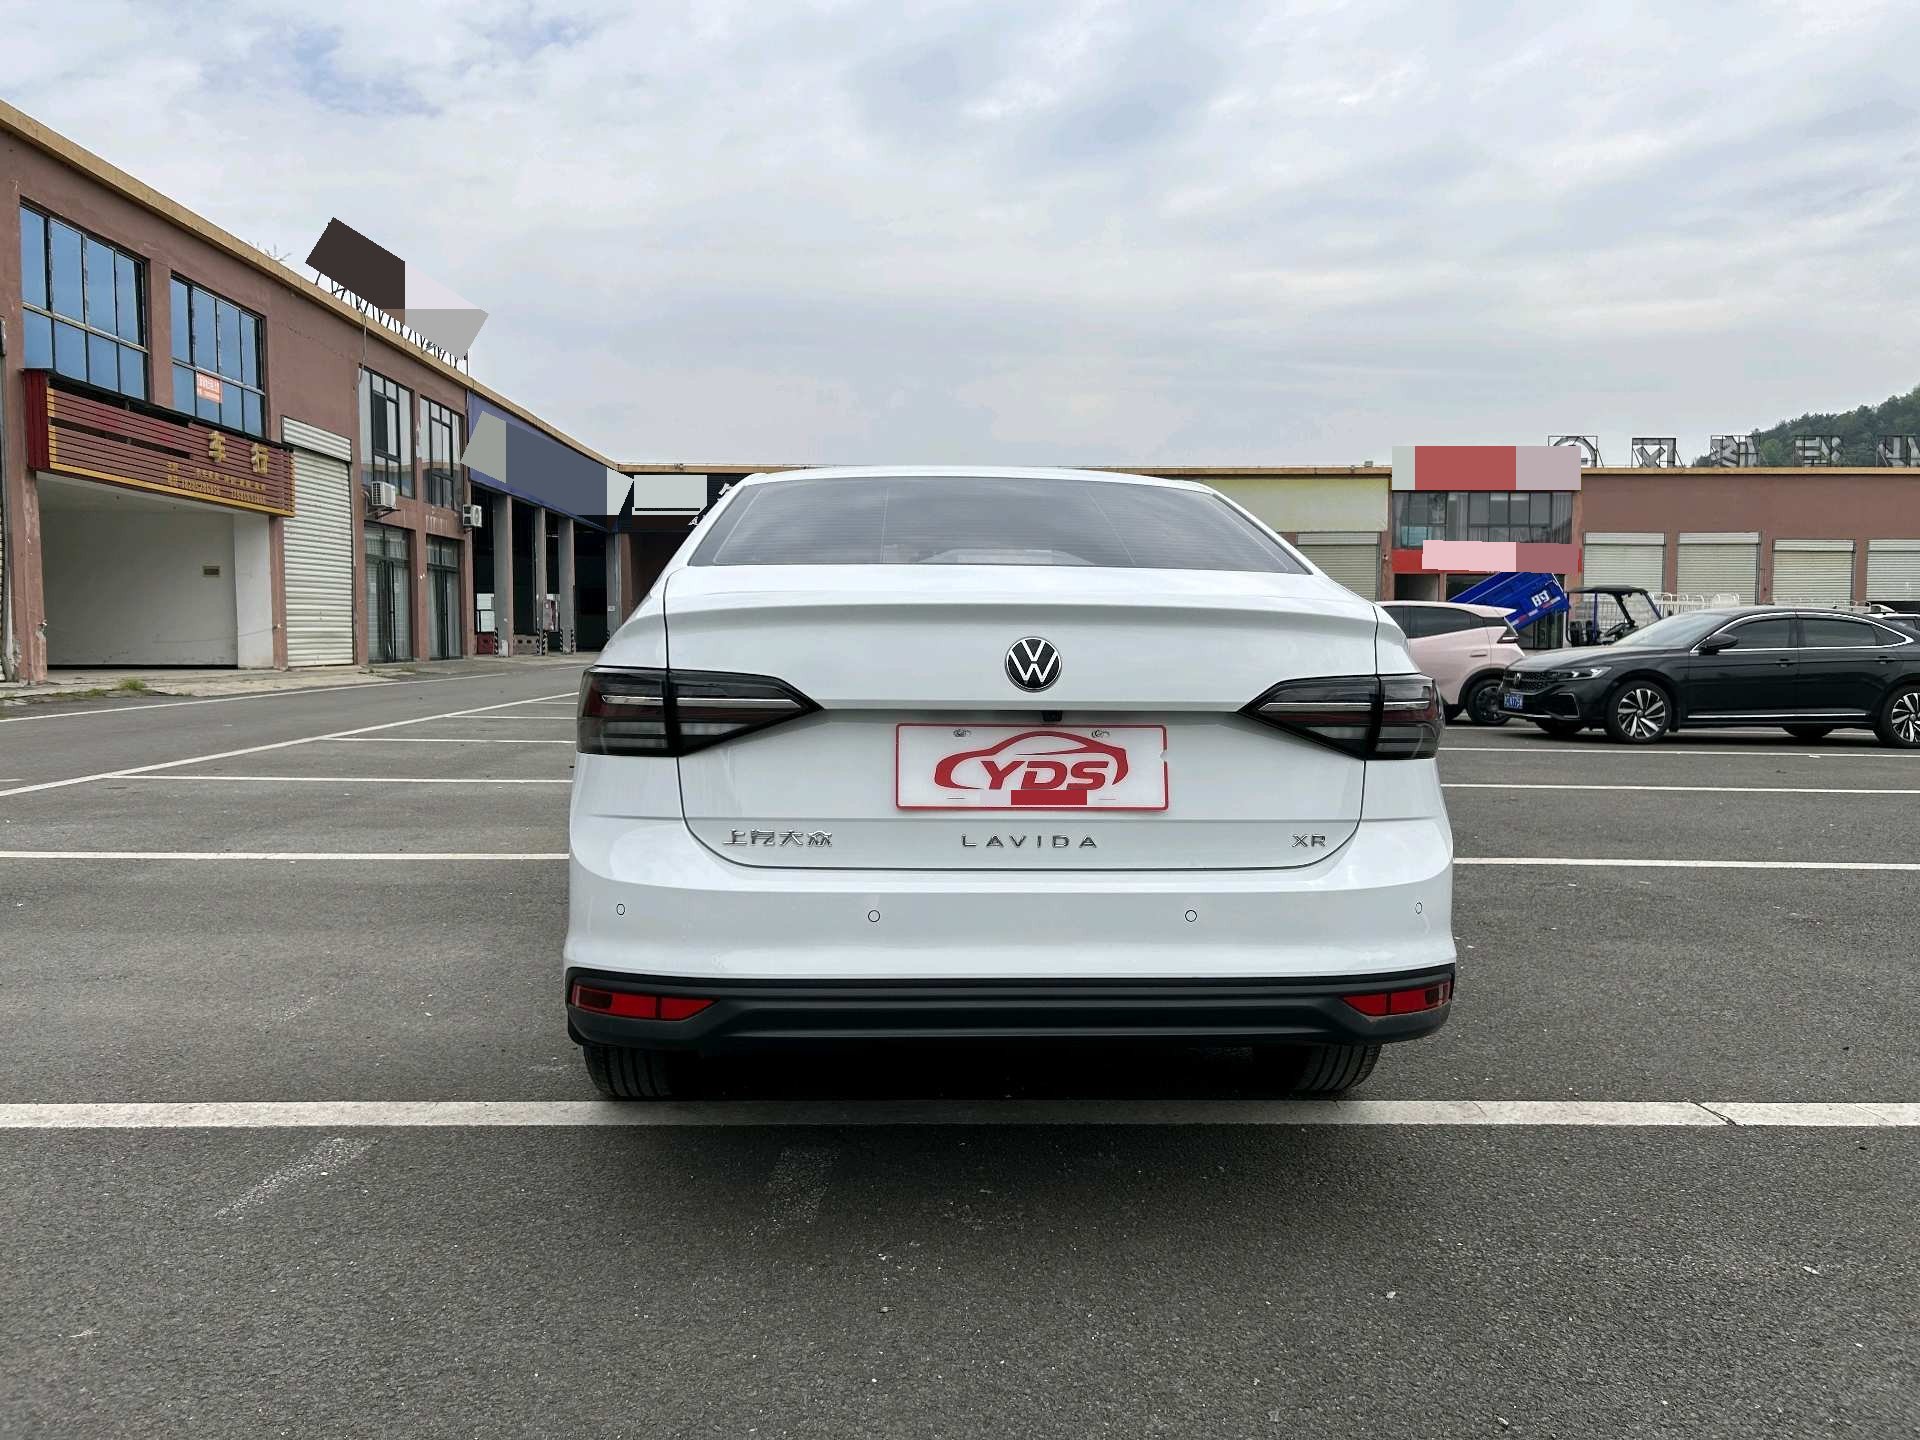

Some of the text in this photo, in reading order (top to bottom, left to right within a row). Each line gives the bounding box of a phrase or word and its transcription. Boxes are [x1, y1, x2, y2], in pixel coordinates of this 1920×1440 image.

[980, 760, 1109, 791] YDS
[722, 829, 833, 847] 上汽大众
[961, 834, 1098, 849] LAVIDA
[1291, 834, 1326, 848] XR
